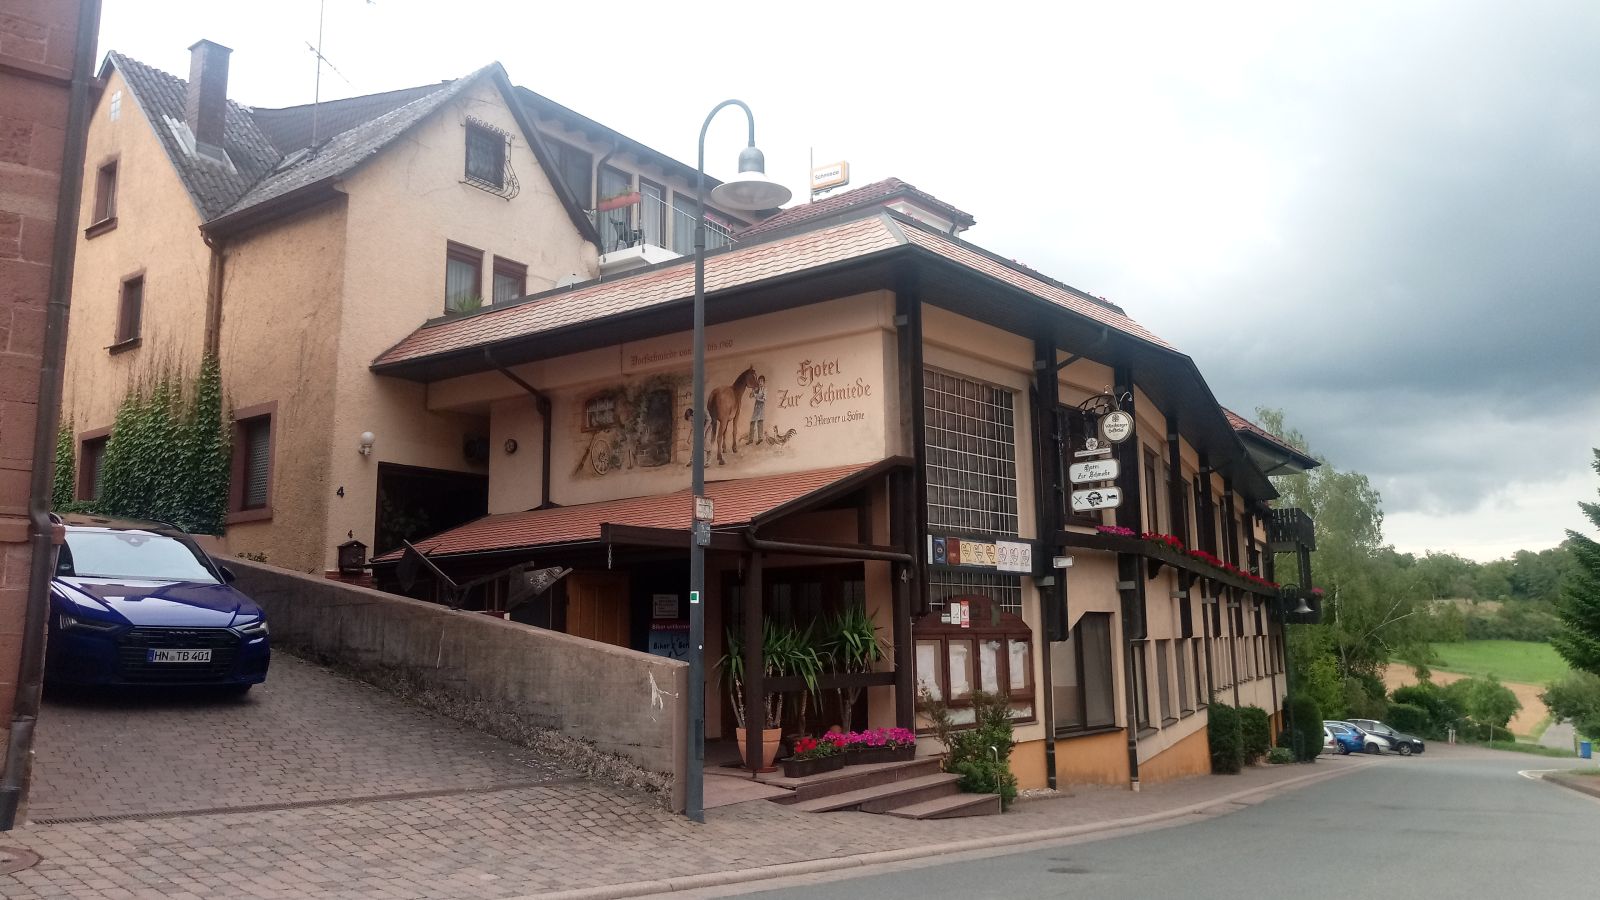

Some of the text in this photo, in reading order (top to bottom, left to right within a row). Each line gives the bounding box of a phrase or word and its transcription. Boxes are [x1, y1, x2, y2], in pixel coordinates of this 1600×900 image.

[797, 359, 841, 387] Hotel
[777, 377, 872, 409] Zur Schmiede
[336, 486, 345, 498] 4
[347, 529, 353, 539] 4
[900, 569, 908, 583] 4
[154, 651, 210, 661] HN TB 401
